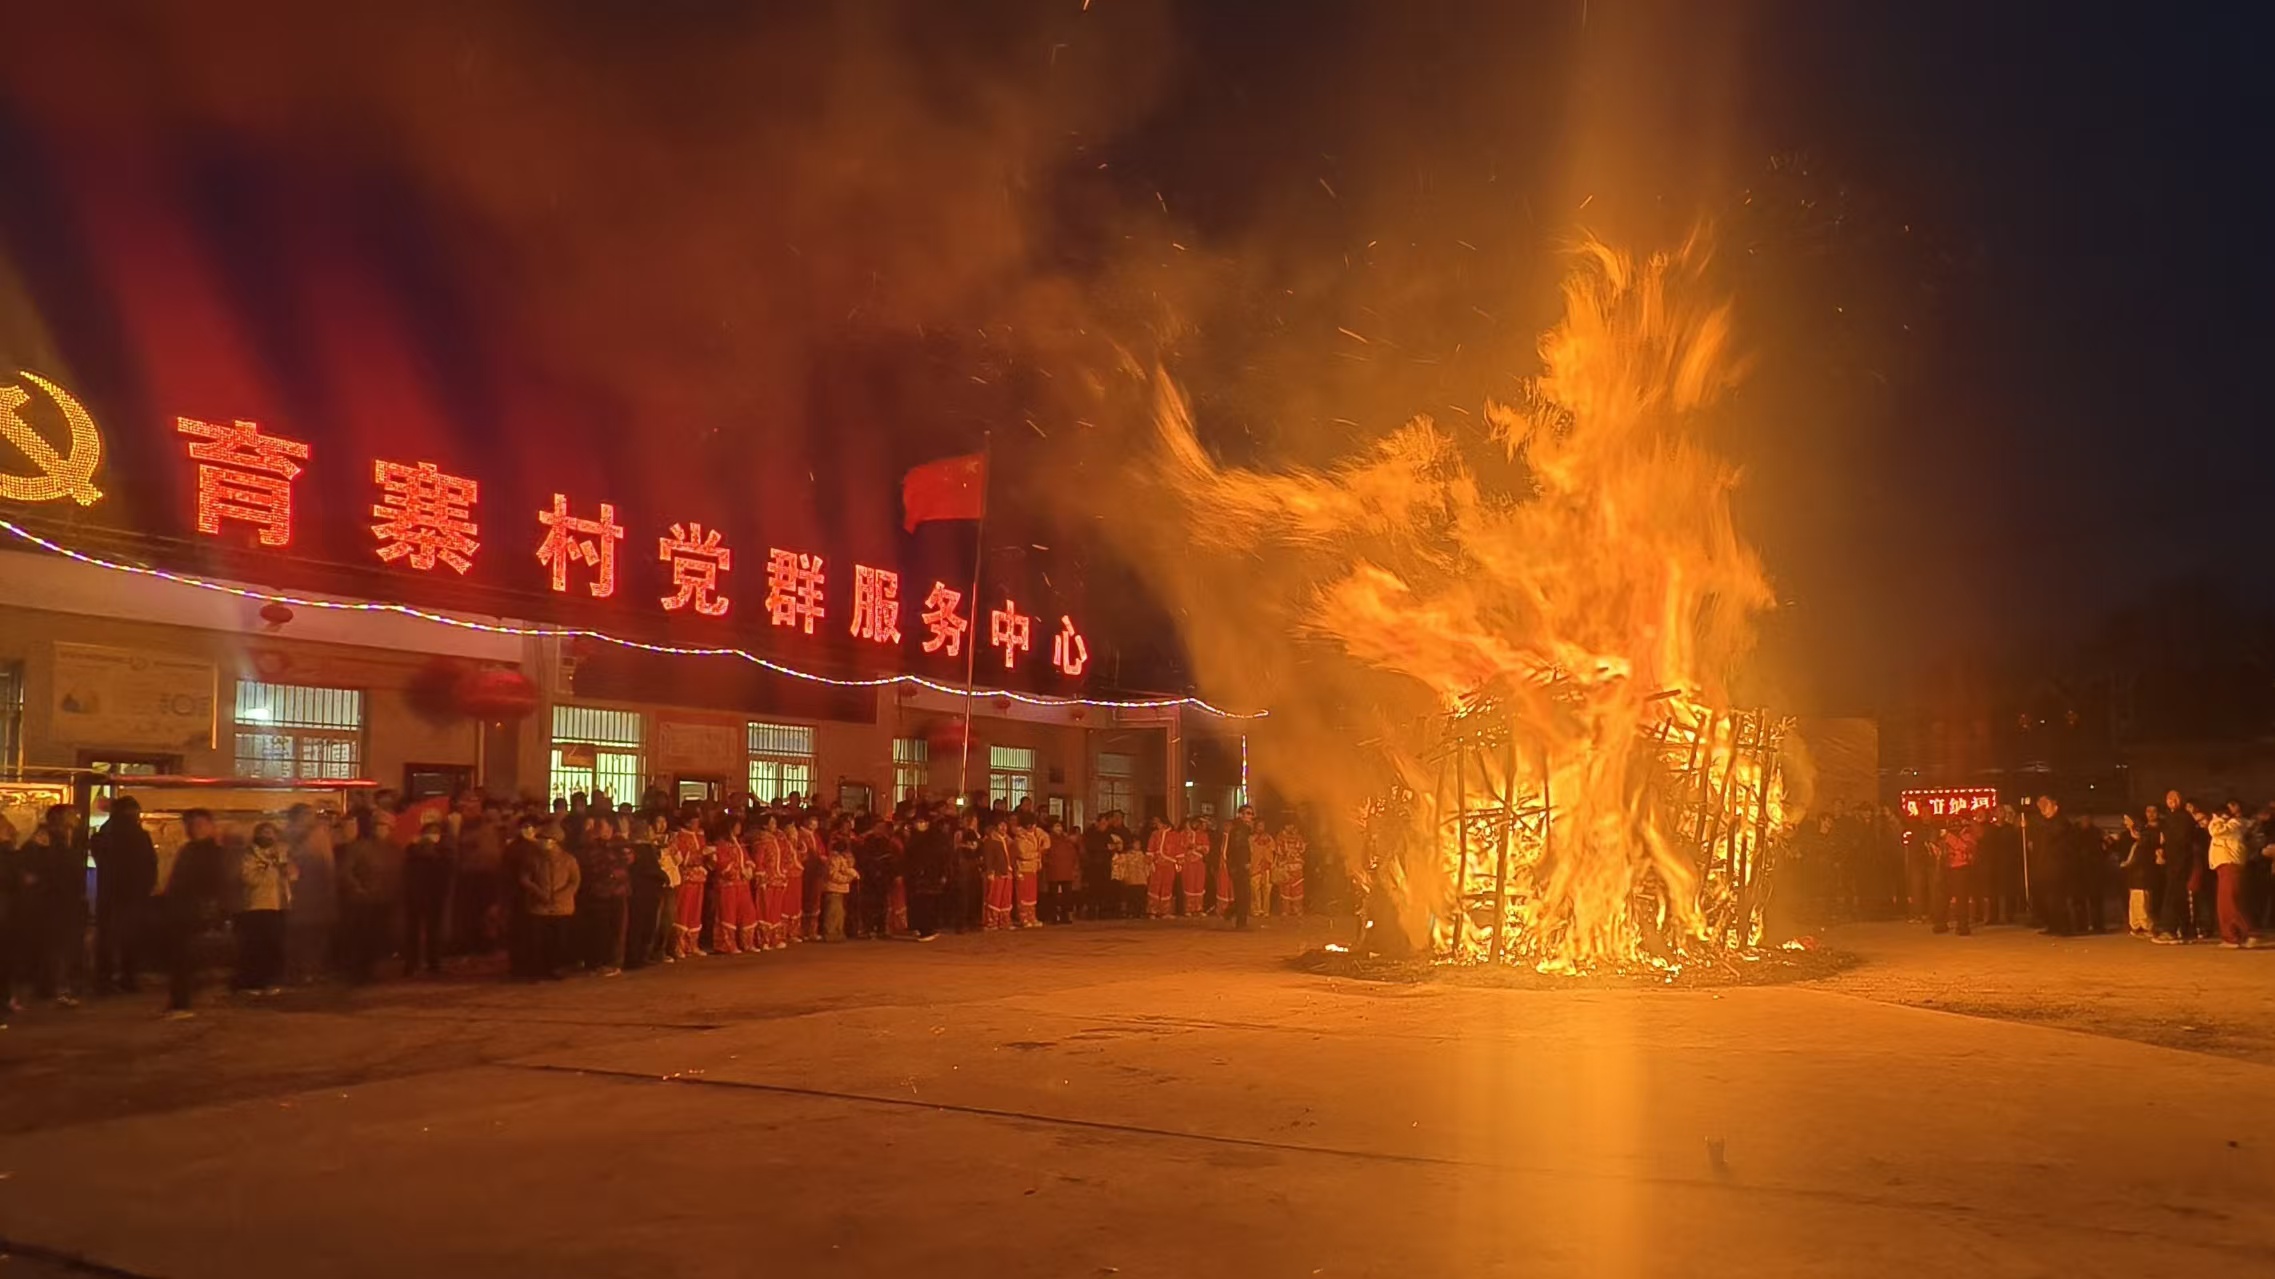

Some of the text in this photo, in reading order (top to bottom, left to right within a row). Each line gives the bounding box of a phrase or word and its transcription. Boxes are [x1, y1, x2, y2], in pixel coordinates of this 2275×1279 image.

[177, 417, 1088, 675] 育寨村党群服务中心
